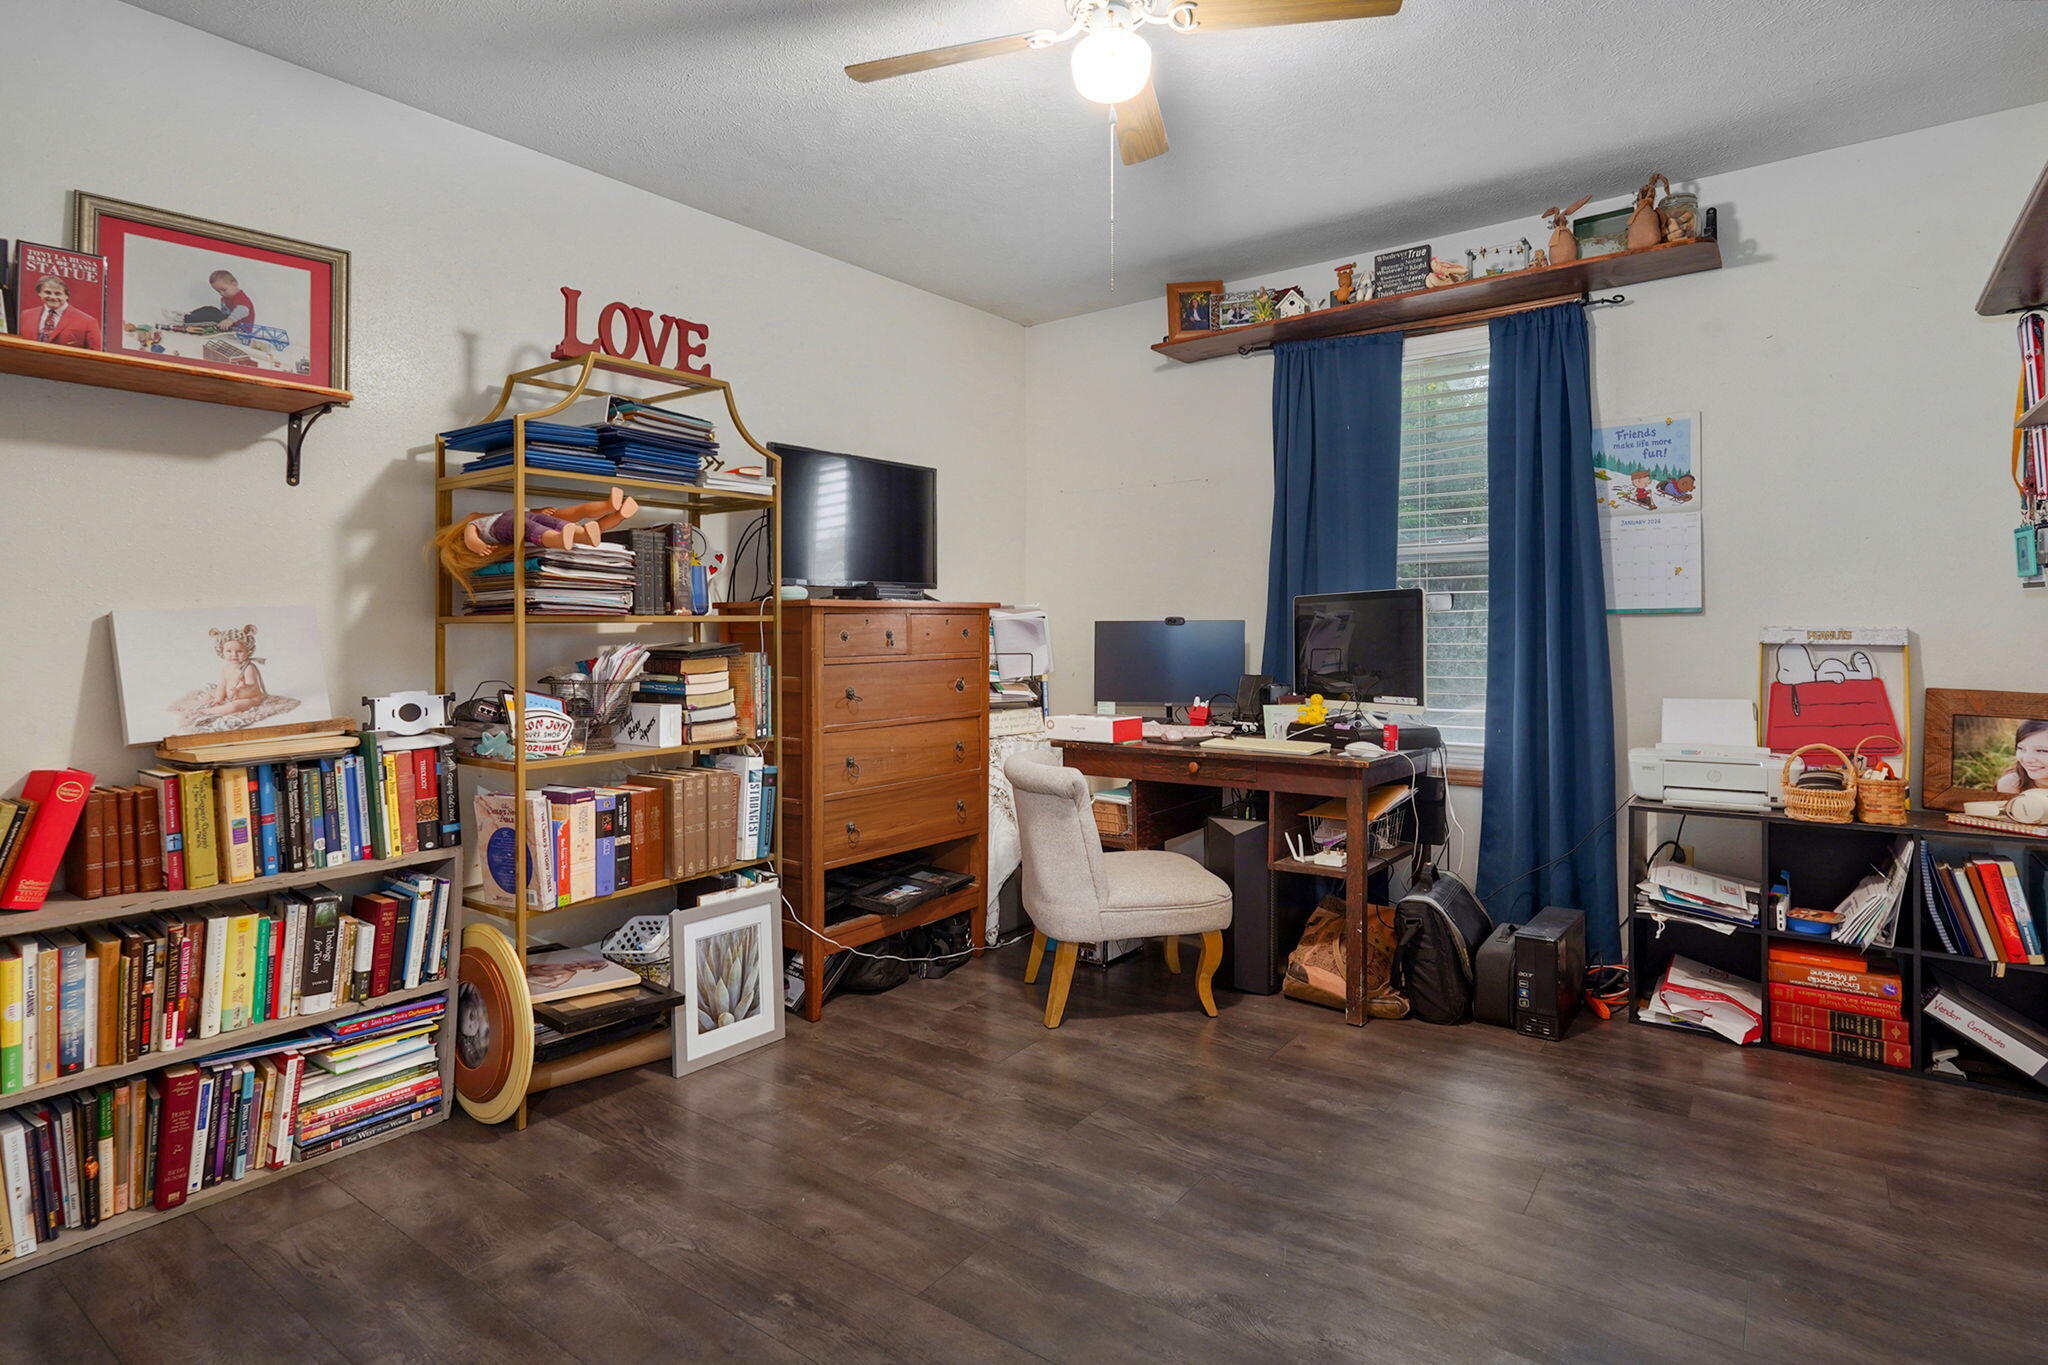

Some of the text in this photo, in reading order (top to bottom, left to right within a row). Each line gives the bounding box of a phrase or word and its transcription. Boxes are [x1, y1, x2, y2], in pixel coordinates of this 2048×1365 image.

[26, 249, 98, 267] TONY LA RUSSA
[1408, 248, 1427, 258] True
[26, 260, 98, 283] STATUE
[553, 286, 711, 378] LOVE
[1616, 428, 1656, 441] Friends
[1637, 440, 1649, 448] life
[1643, 448, 1667, 459] fun!
[1807, 630, 1853, 641] PEANUTS
[546, 720, 568, 731] JON
[446, 772, 454, 794] Grasping
[748, 783, 760, 838] STRONGEST
[311, 939, 322, 974] for Today
[323, 928, 335, 963] Theology
[146, 944, 155, 977] BILL O'REILLY
[169, 955, 177, 971] MAN
[182, 946, 191, 974] UNVEILED
[67, 950, 79, 1020] SARAH PALIN
[131, 963, 139, 990] FERGUSON
[1807, 976, 1860, 990] Encyclopedia
[1810, 969, 1857, 982] of Medicine
[167, 976, 178, 998] FAITH
[180, 980, 189, 995] LAST
[25, 990, 35, 1018] CANNING
[1933, 999, 1961, 1021] Vendor
[143, 996, 152, 1044] CULTURE WARRIOR
[71, 1023, 79, 1057] Going Rogue
[1967, 1020, 2006, 1049] Contracts
[374, 1087, 411, 1102] BETH MOORE
[241, 1103, 251, 1119] Jesus
[324, 1104, 353, 1118] DANIEL
[239, 1129, 249, 1150] Christ
